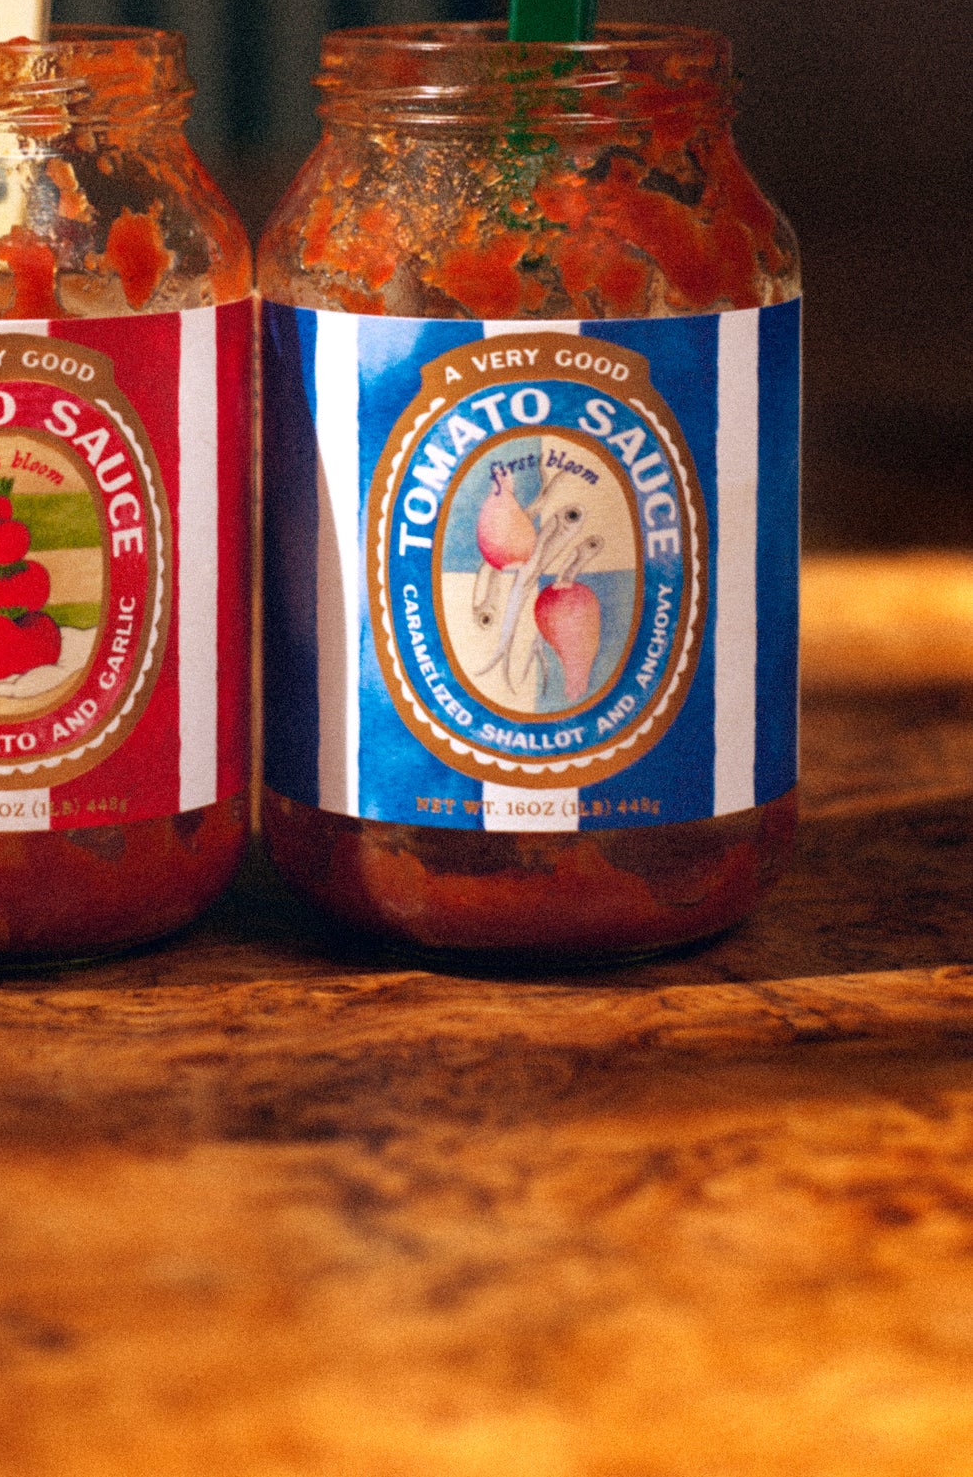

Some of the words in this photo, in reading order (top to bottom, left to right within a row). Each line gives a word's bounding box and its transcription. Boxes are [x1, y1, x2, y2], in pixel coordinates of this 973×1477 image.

[22, 350, 95, 382] GOOD
[444, 366, 463, 384] A
[471, 348, 540, 372] VERY
[554, 349, 630, 382] GOOD
[11, 450, 65, 486] bloom
[43, 400, 144, 558] SAUCE
[398, 387, 551, 556] TOMATO
[577, 398, 680, 559] SAUCE
[489, 453, 535, 496] first
[545, 449, 600, 485] bloom
[51, 698, 98, 742] AND
[98, 596, 136, 690] GARLIC
[402, 583, 473, 726] CARAMELIZED
[479, 723, 585, 750] SHALLOT
[596, 694, 636, 735] AND
[635, 583, 673, 690] ANCHOVY
[32, 798, 80, 818] (1LB)
[415, 796, 456, 815] NET
[463, 800, 499, 816] WT.
[507, 801, 555, 816] 16OZ
[561, 798, 612, 817] (1LB)
